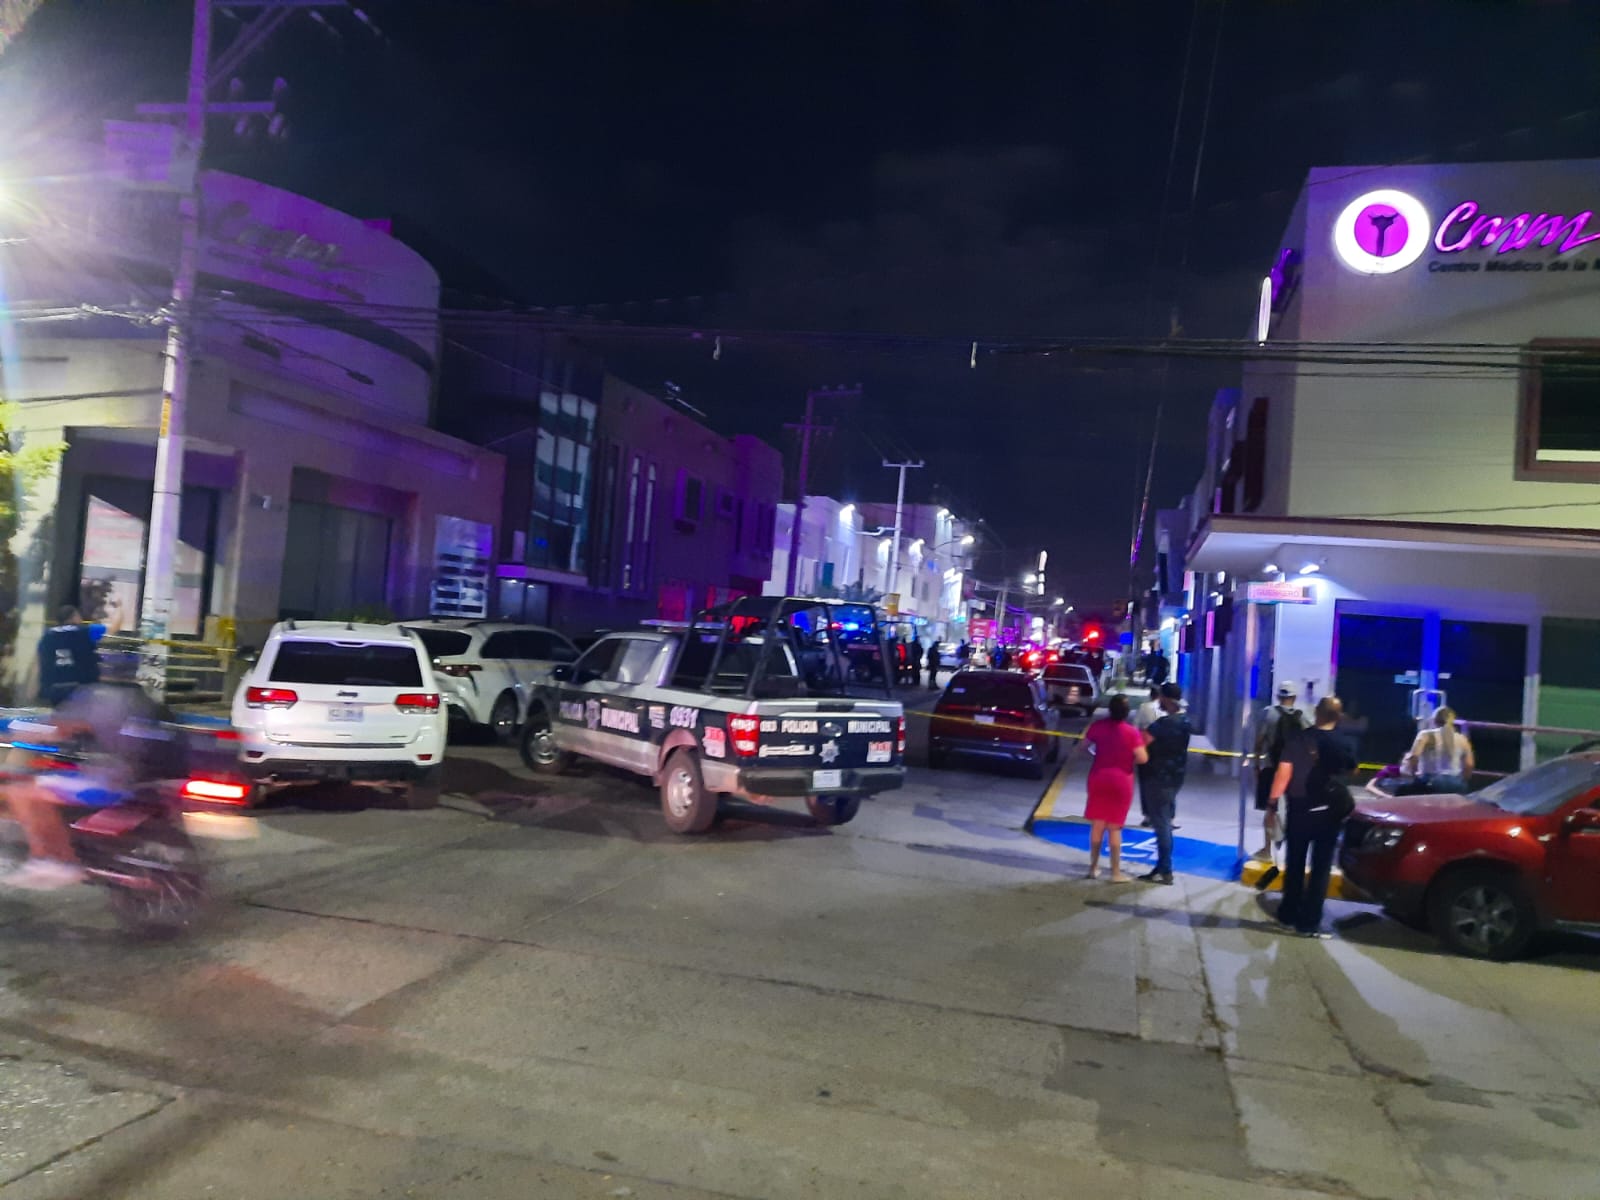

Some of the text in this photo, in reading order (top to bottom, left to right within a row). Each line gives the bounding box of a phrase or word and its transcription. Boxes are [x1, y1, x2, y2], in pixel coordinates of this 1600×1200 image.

[1428, 260, 1480, 272] Centro
[1548, 259, 1569, 271] de
[1574, 258, 1587, 271] la
[781, 719, 818, 734] POLICIA
[847, 720, 891, 733] MUNICIPAL
